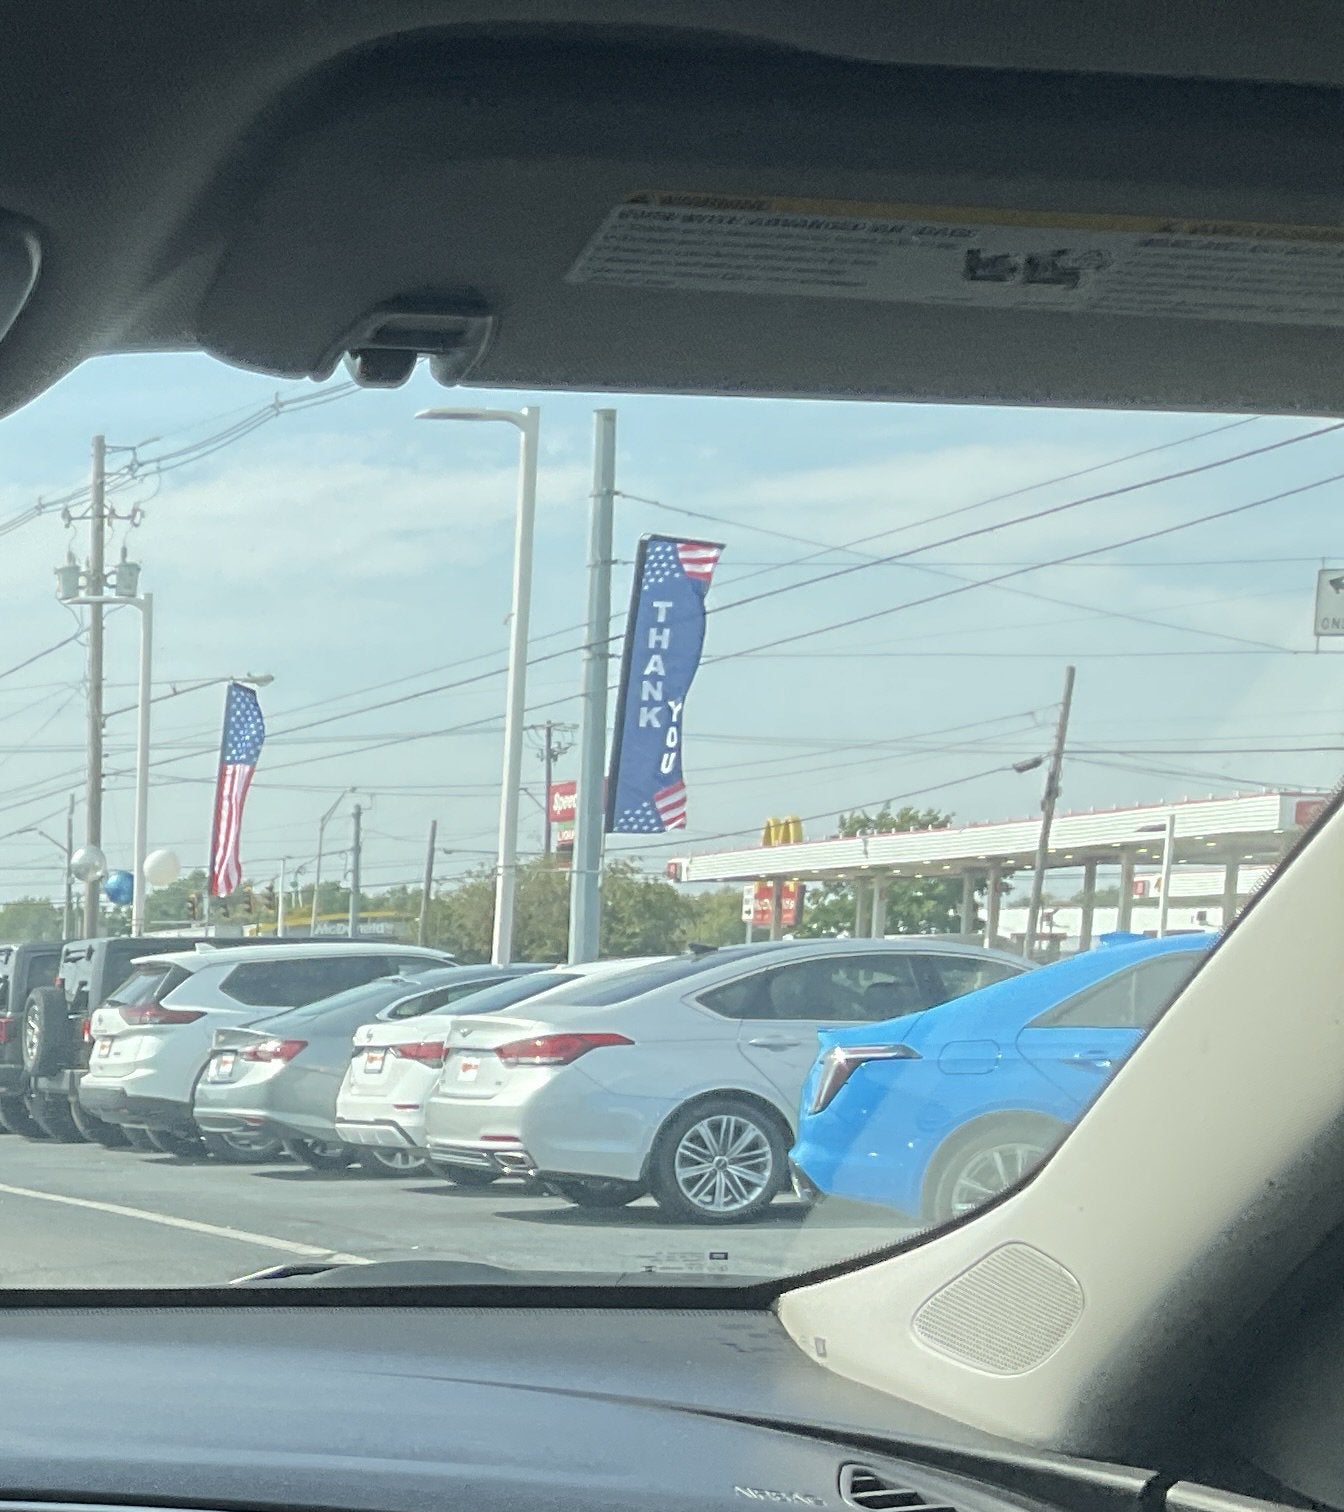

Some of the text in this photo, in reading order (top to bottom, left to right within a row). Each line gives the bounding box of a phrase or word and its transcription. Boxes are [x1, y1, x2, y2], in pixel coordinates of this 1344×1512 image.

[638, 600, 674, 729] THANK
[659, 699, 683, 775] YOU
[314, 921, 394, 935] McDnald's
